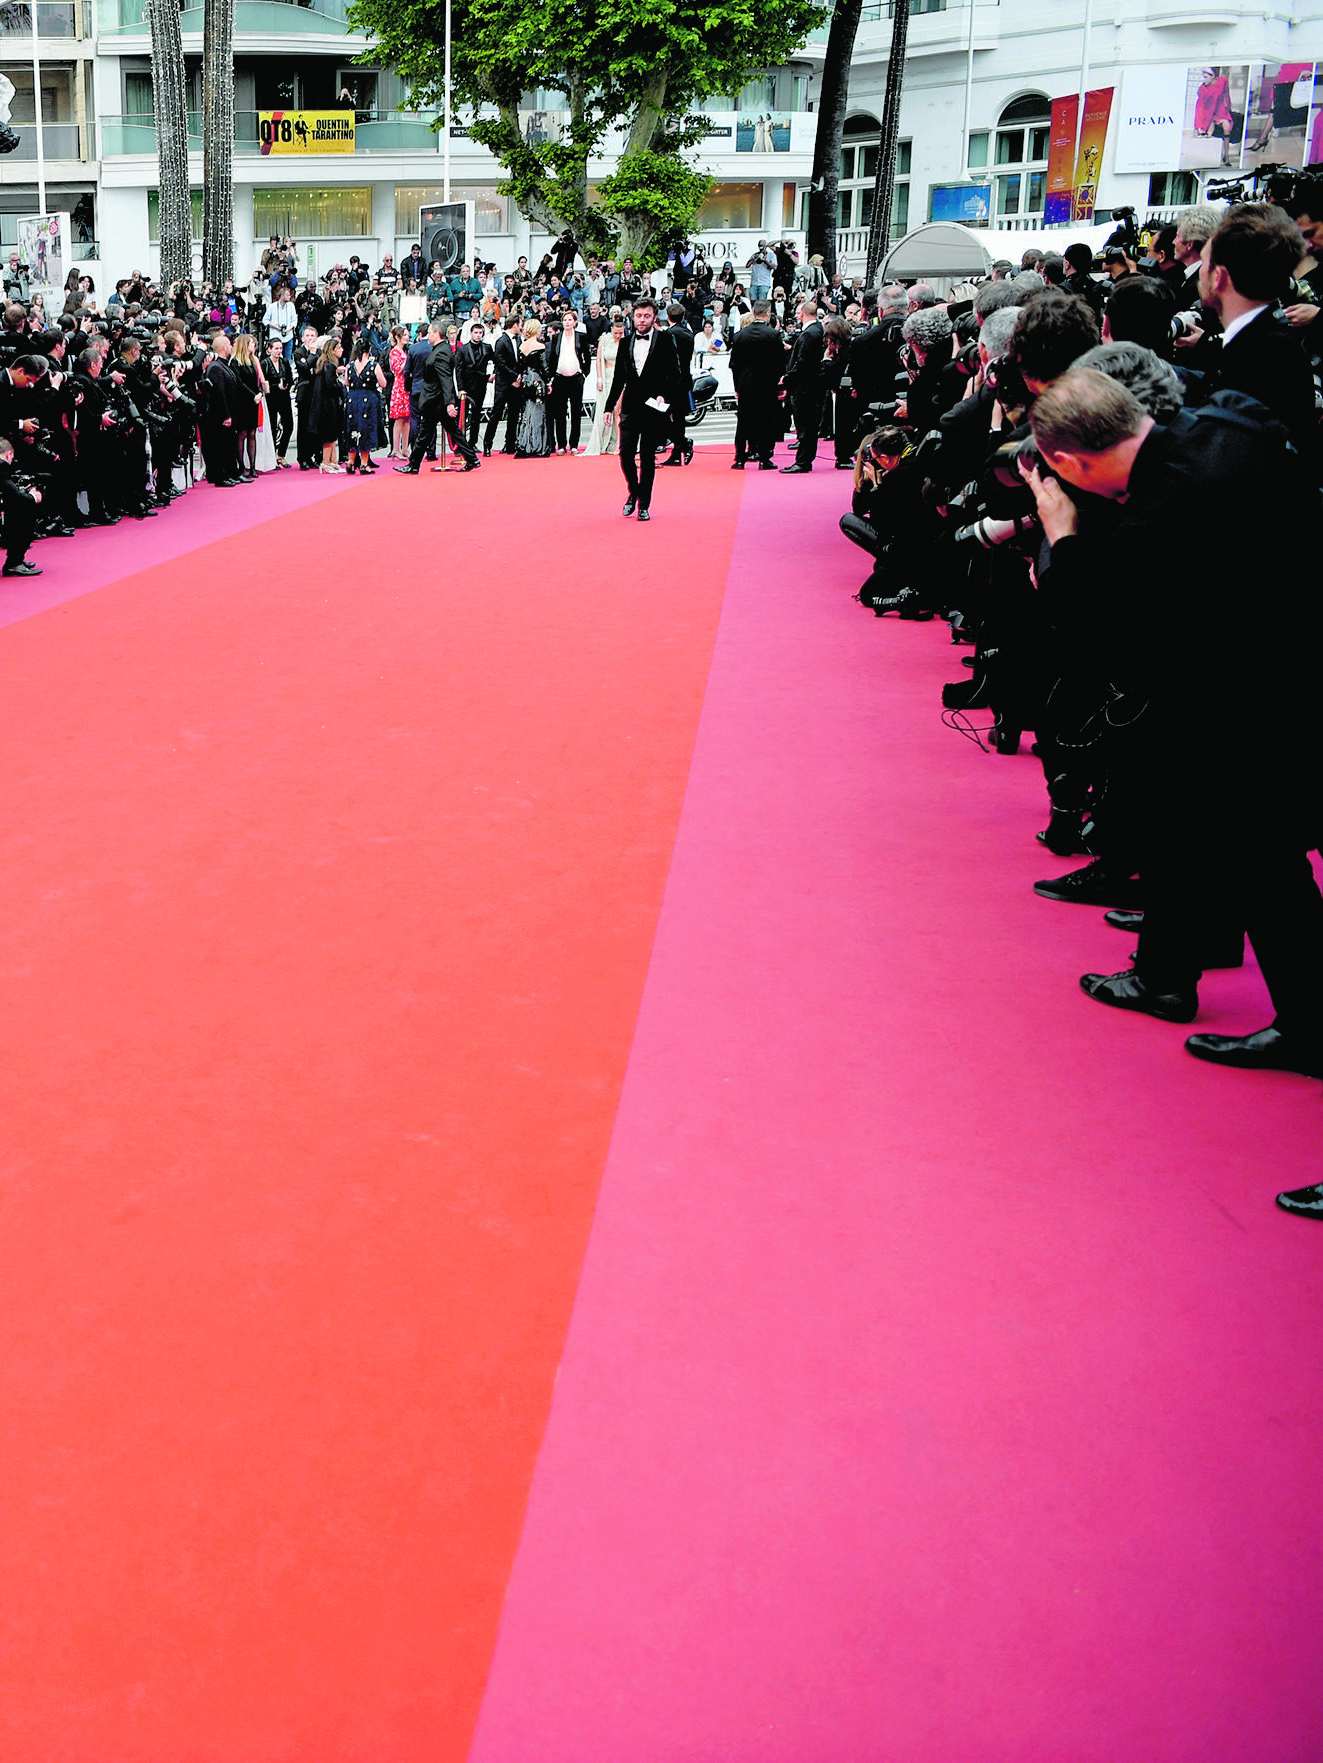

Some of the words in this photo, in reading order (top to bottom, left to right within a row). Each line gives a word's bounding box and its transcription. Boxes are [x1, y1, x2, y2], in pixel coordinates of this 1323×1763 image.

[316, 119, 350, 130] QUENTIN
[1128, 116, 1174, 126] PRADA
[260, 119, 292, 144] QT8
[311, 129, 354, 140] TARANTINO
